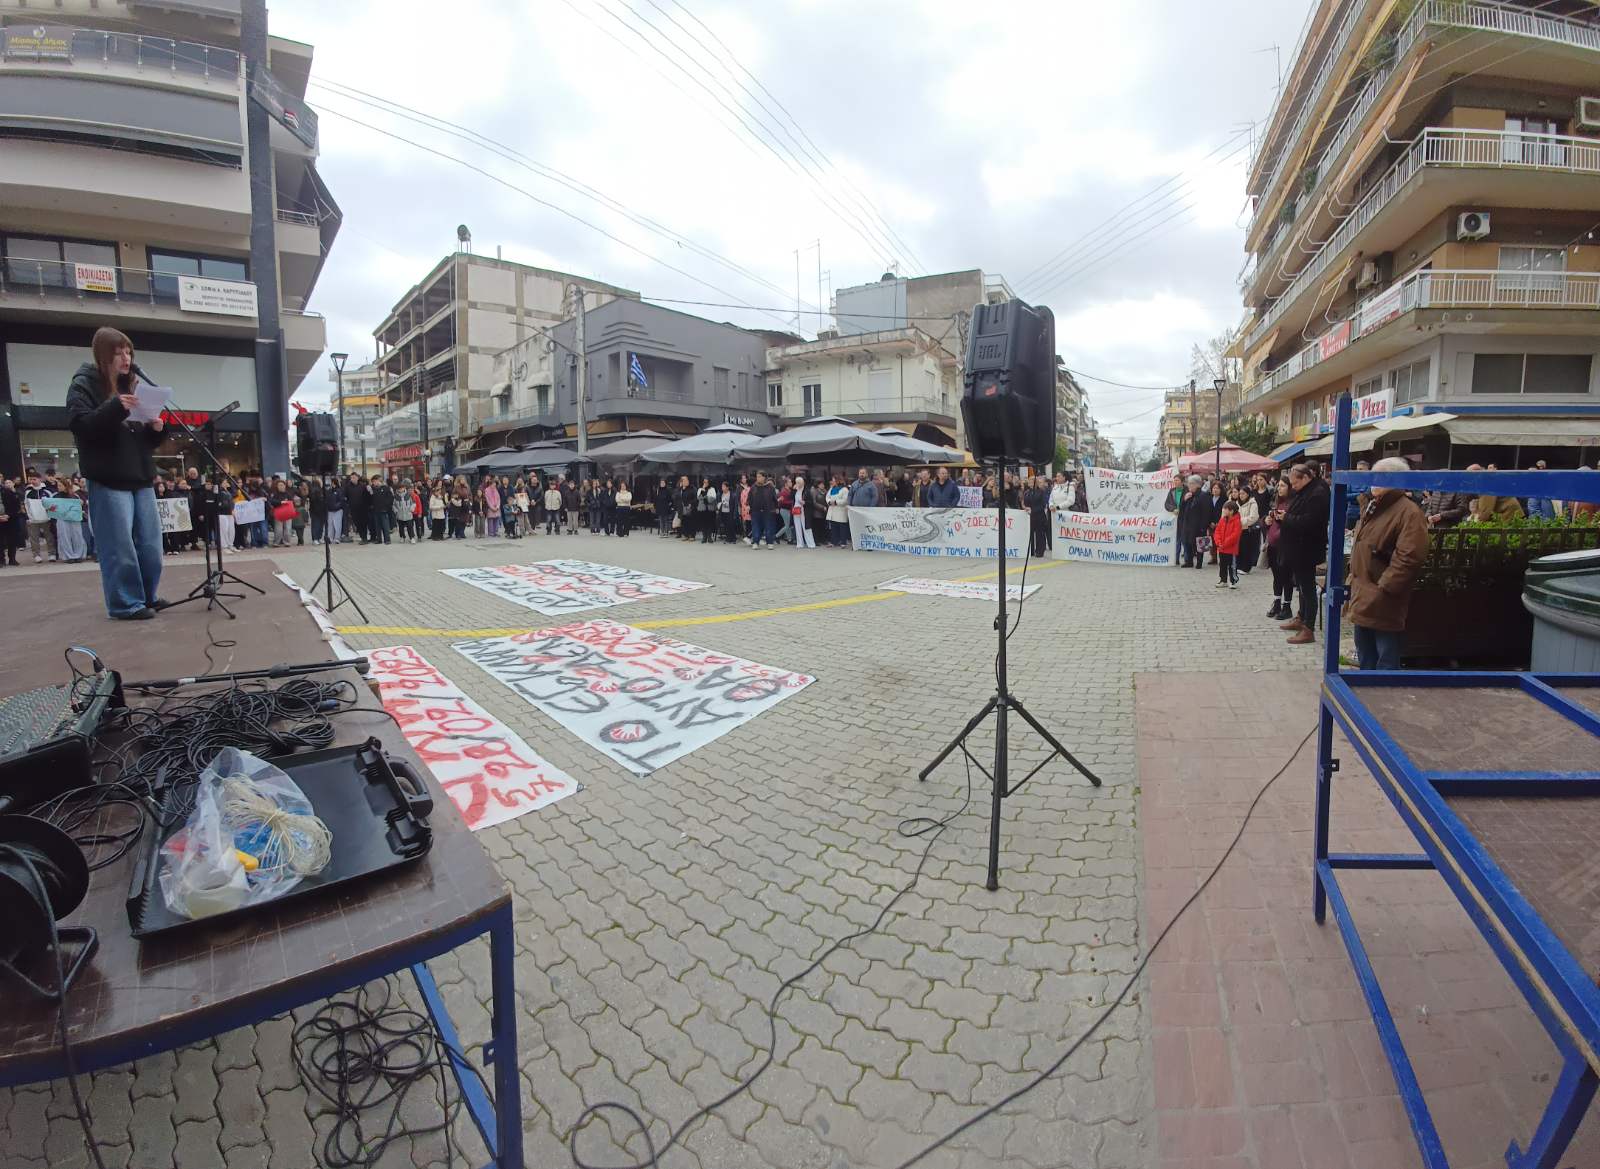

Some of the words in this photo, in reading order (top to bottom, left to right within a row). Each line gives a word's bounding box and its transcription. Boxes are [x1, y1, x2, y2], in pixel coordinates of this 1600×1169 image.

[1361, 399, 1387, 418] Pizza
[1071, 514, 1106, 525] ΠΥΞΙΔΑ
[1060, 527, 1113, 541] ΠΑΛΕΥΟΥΜΕ
[945, 546, 970, 556] ΤΟΜΕΑ
[1068, 546, 1092, 557] ΟΜΑΔΑ
[1097, 550, 1130, 562] ΓΥΝΑΙΚΩΝ
[619, 676, 744, 729] ΑΥΤΟ
[600, 720, 681, 770] ΤΟ
